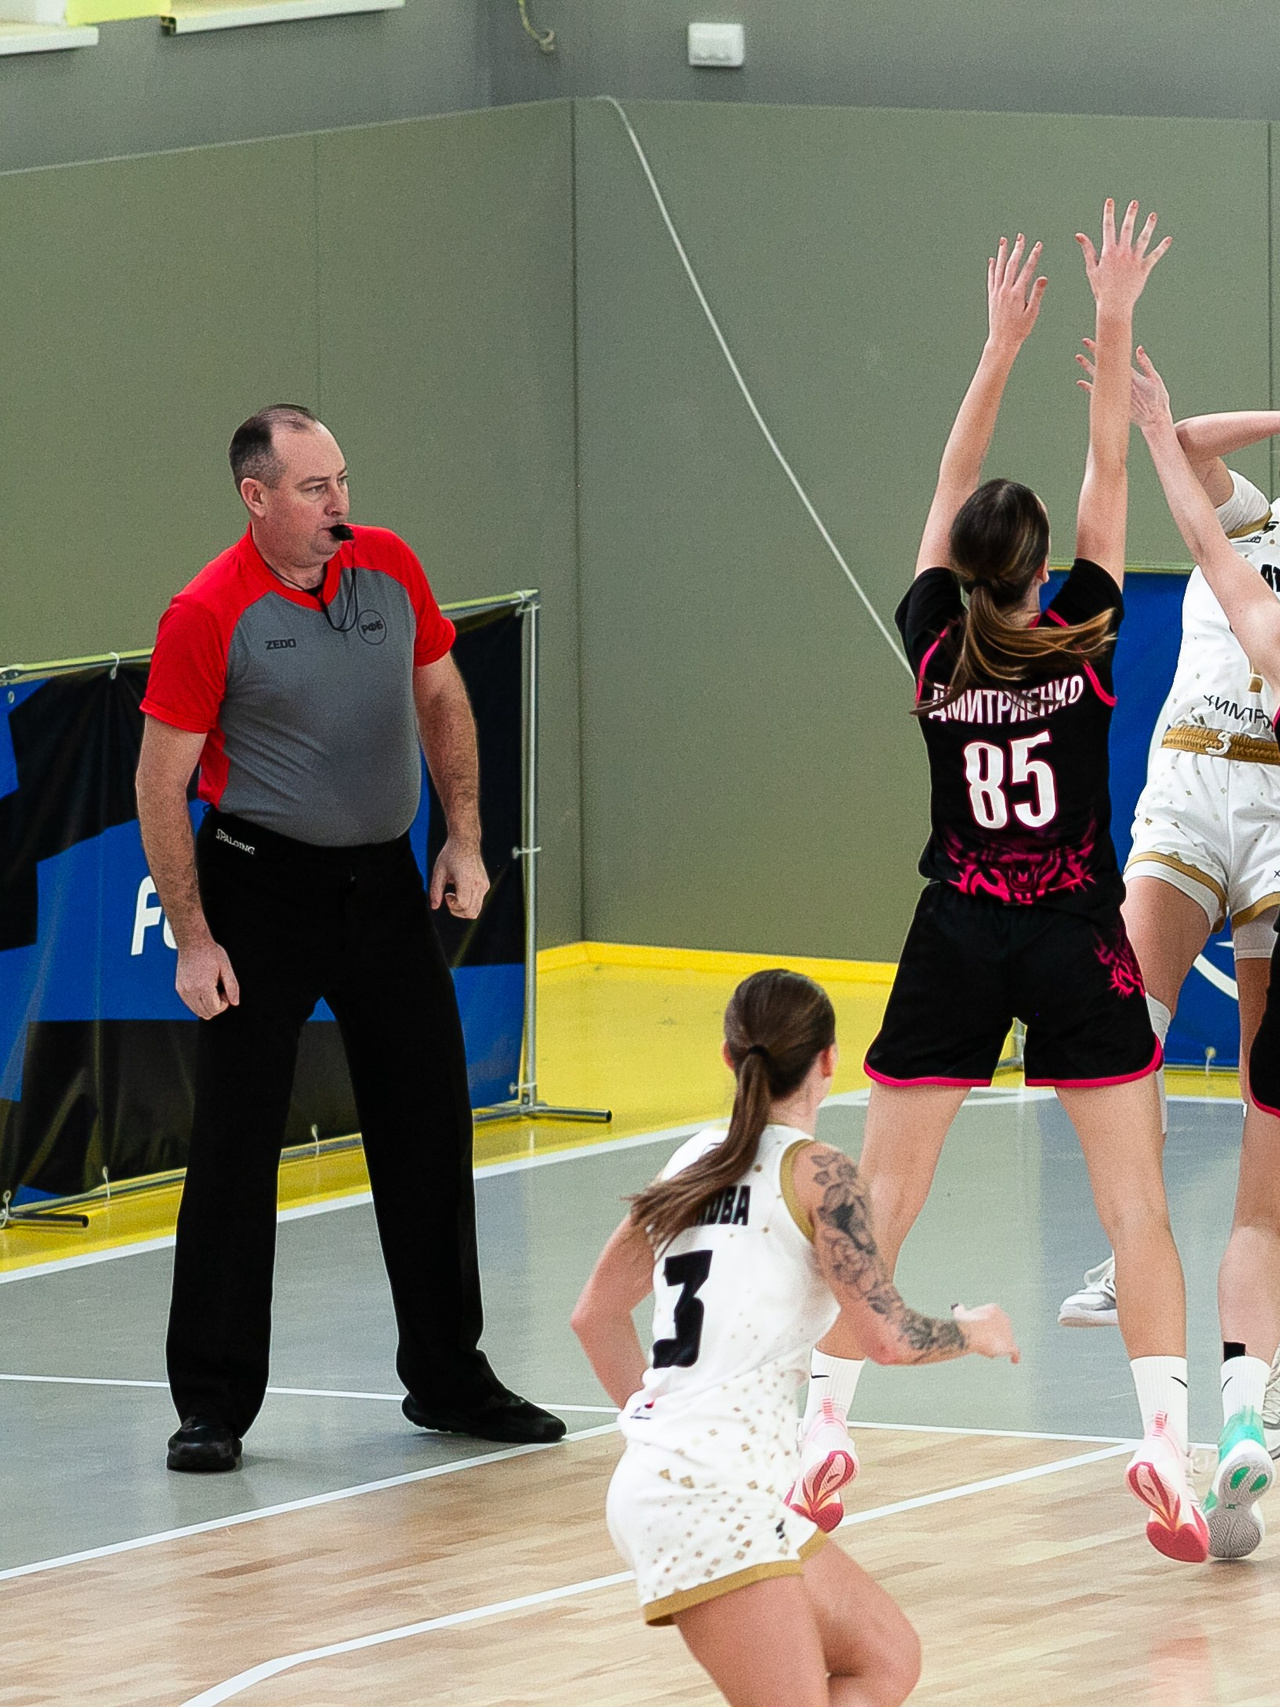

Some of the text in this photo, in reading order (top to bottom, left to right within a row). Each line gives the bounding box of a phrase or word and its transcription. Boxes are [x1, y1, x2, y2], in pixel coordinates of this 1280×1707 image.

[265, 638, 297, 650] ZEDO
[963, 730, 1058, 830] 85
[216, 828, 256, 855] SPALDING
[653, 1250, 713, 1369] 3
